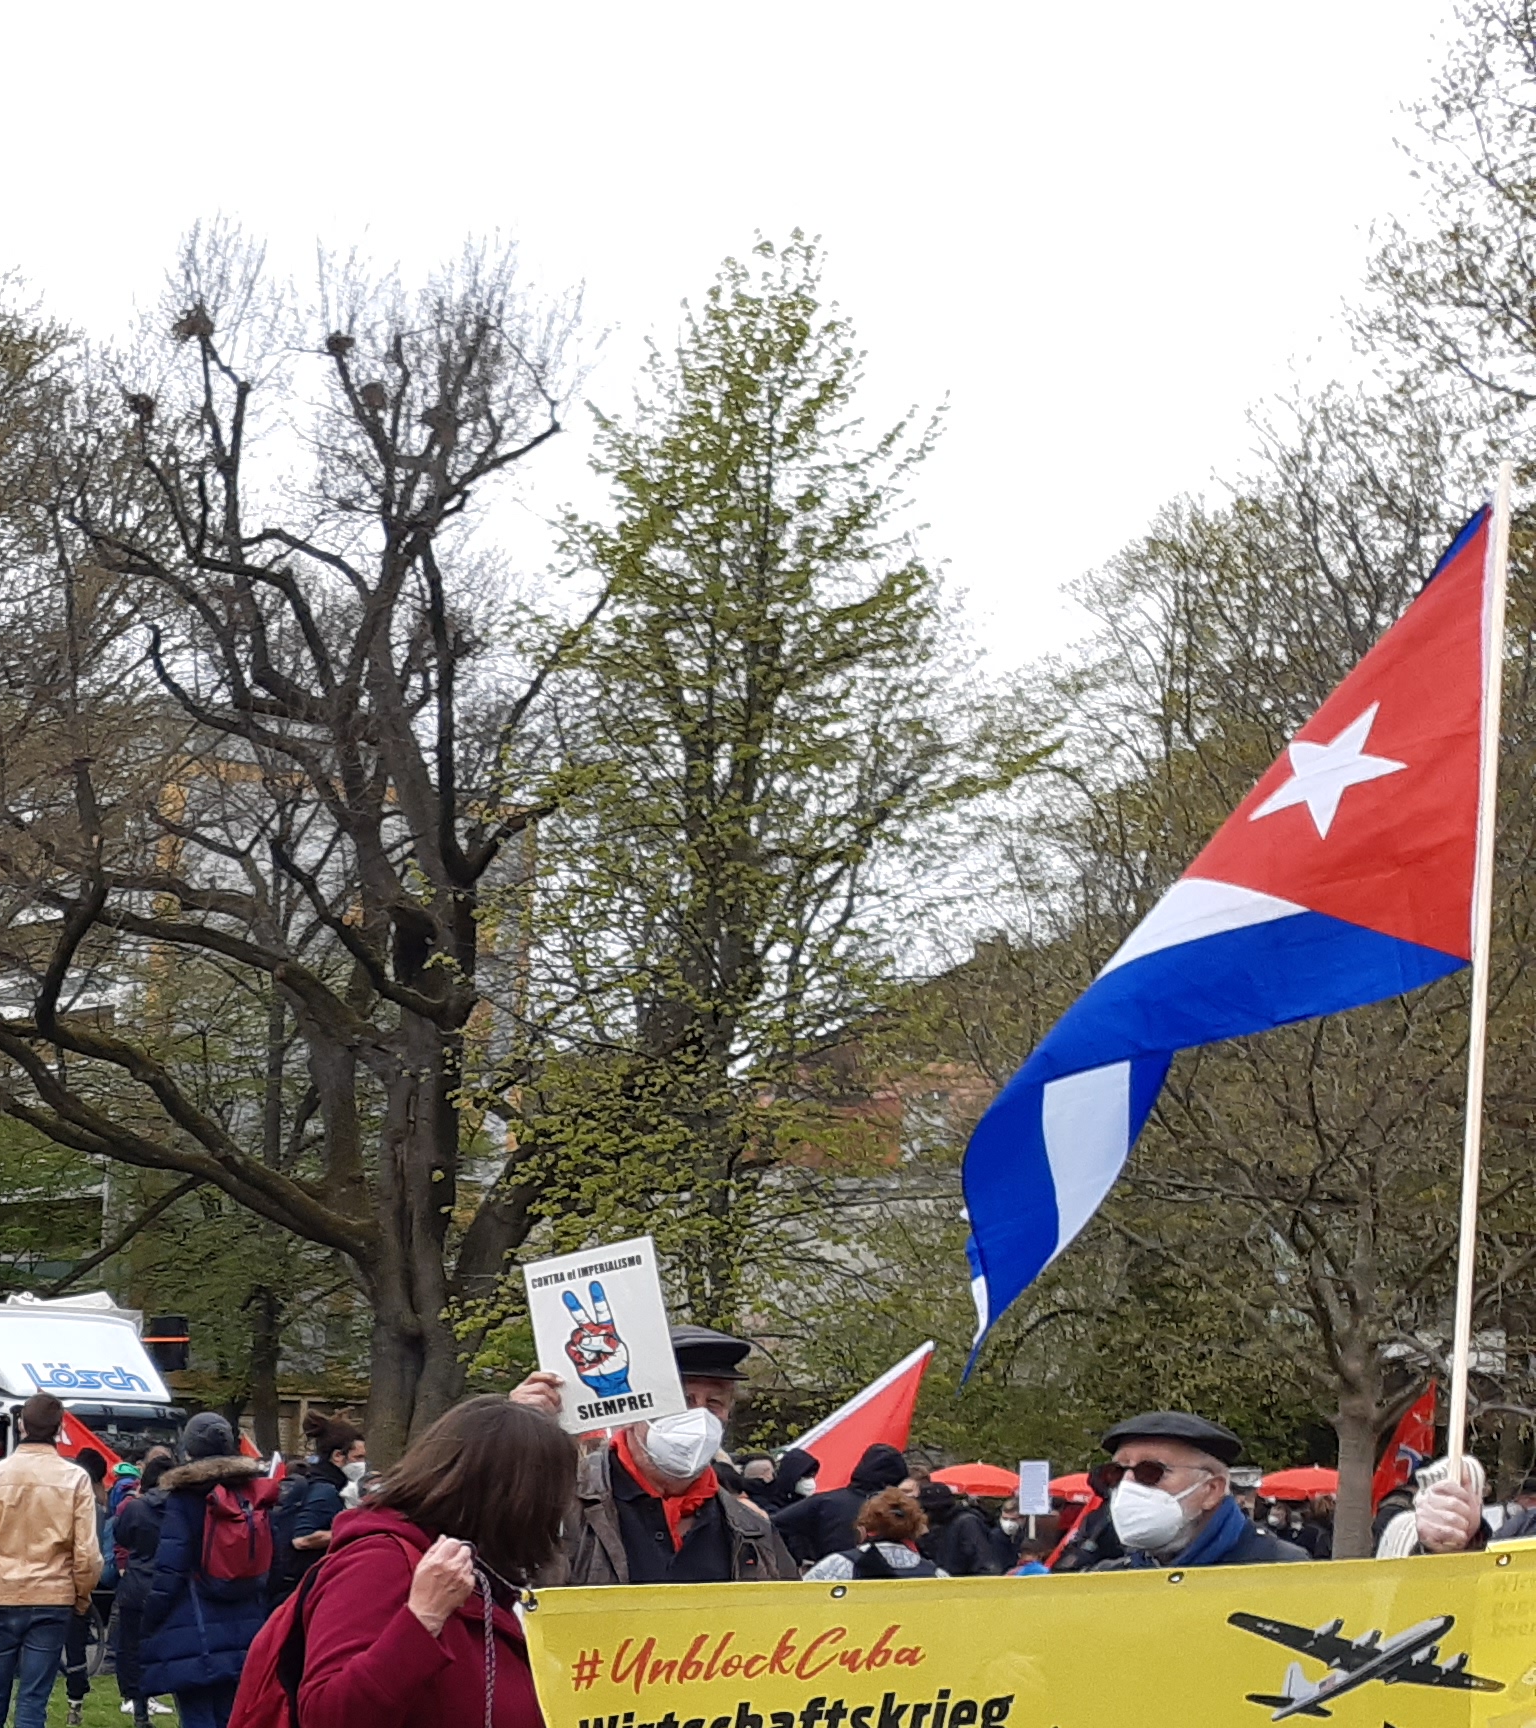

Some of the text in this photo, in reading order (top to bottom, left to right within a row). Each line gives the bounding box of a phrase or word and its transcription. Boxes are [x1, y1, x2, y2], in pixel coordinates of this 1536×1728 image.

[532, 1272, 565, 1289] CONTRA
[577, 1255, 642, 1278] IMPERIALISMO
[22, 1362, 151, 1392] Lösch
[578, 1393, 654, 1420] SIEMPRE!
[571, 1624, 927, 1694] #UnblockCuba
